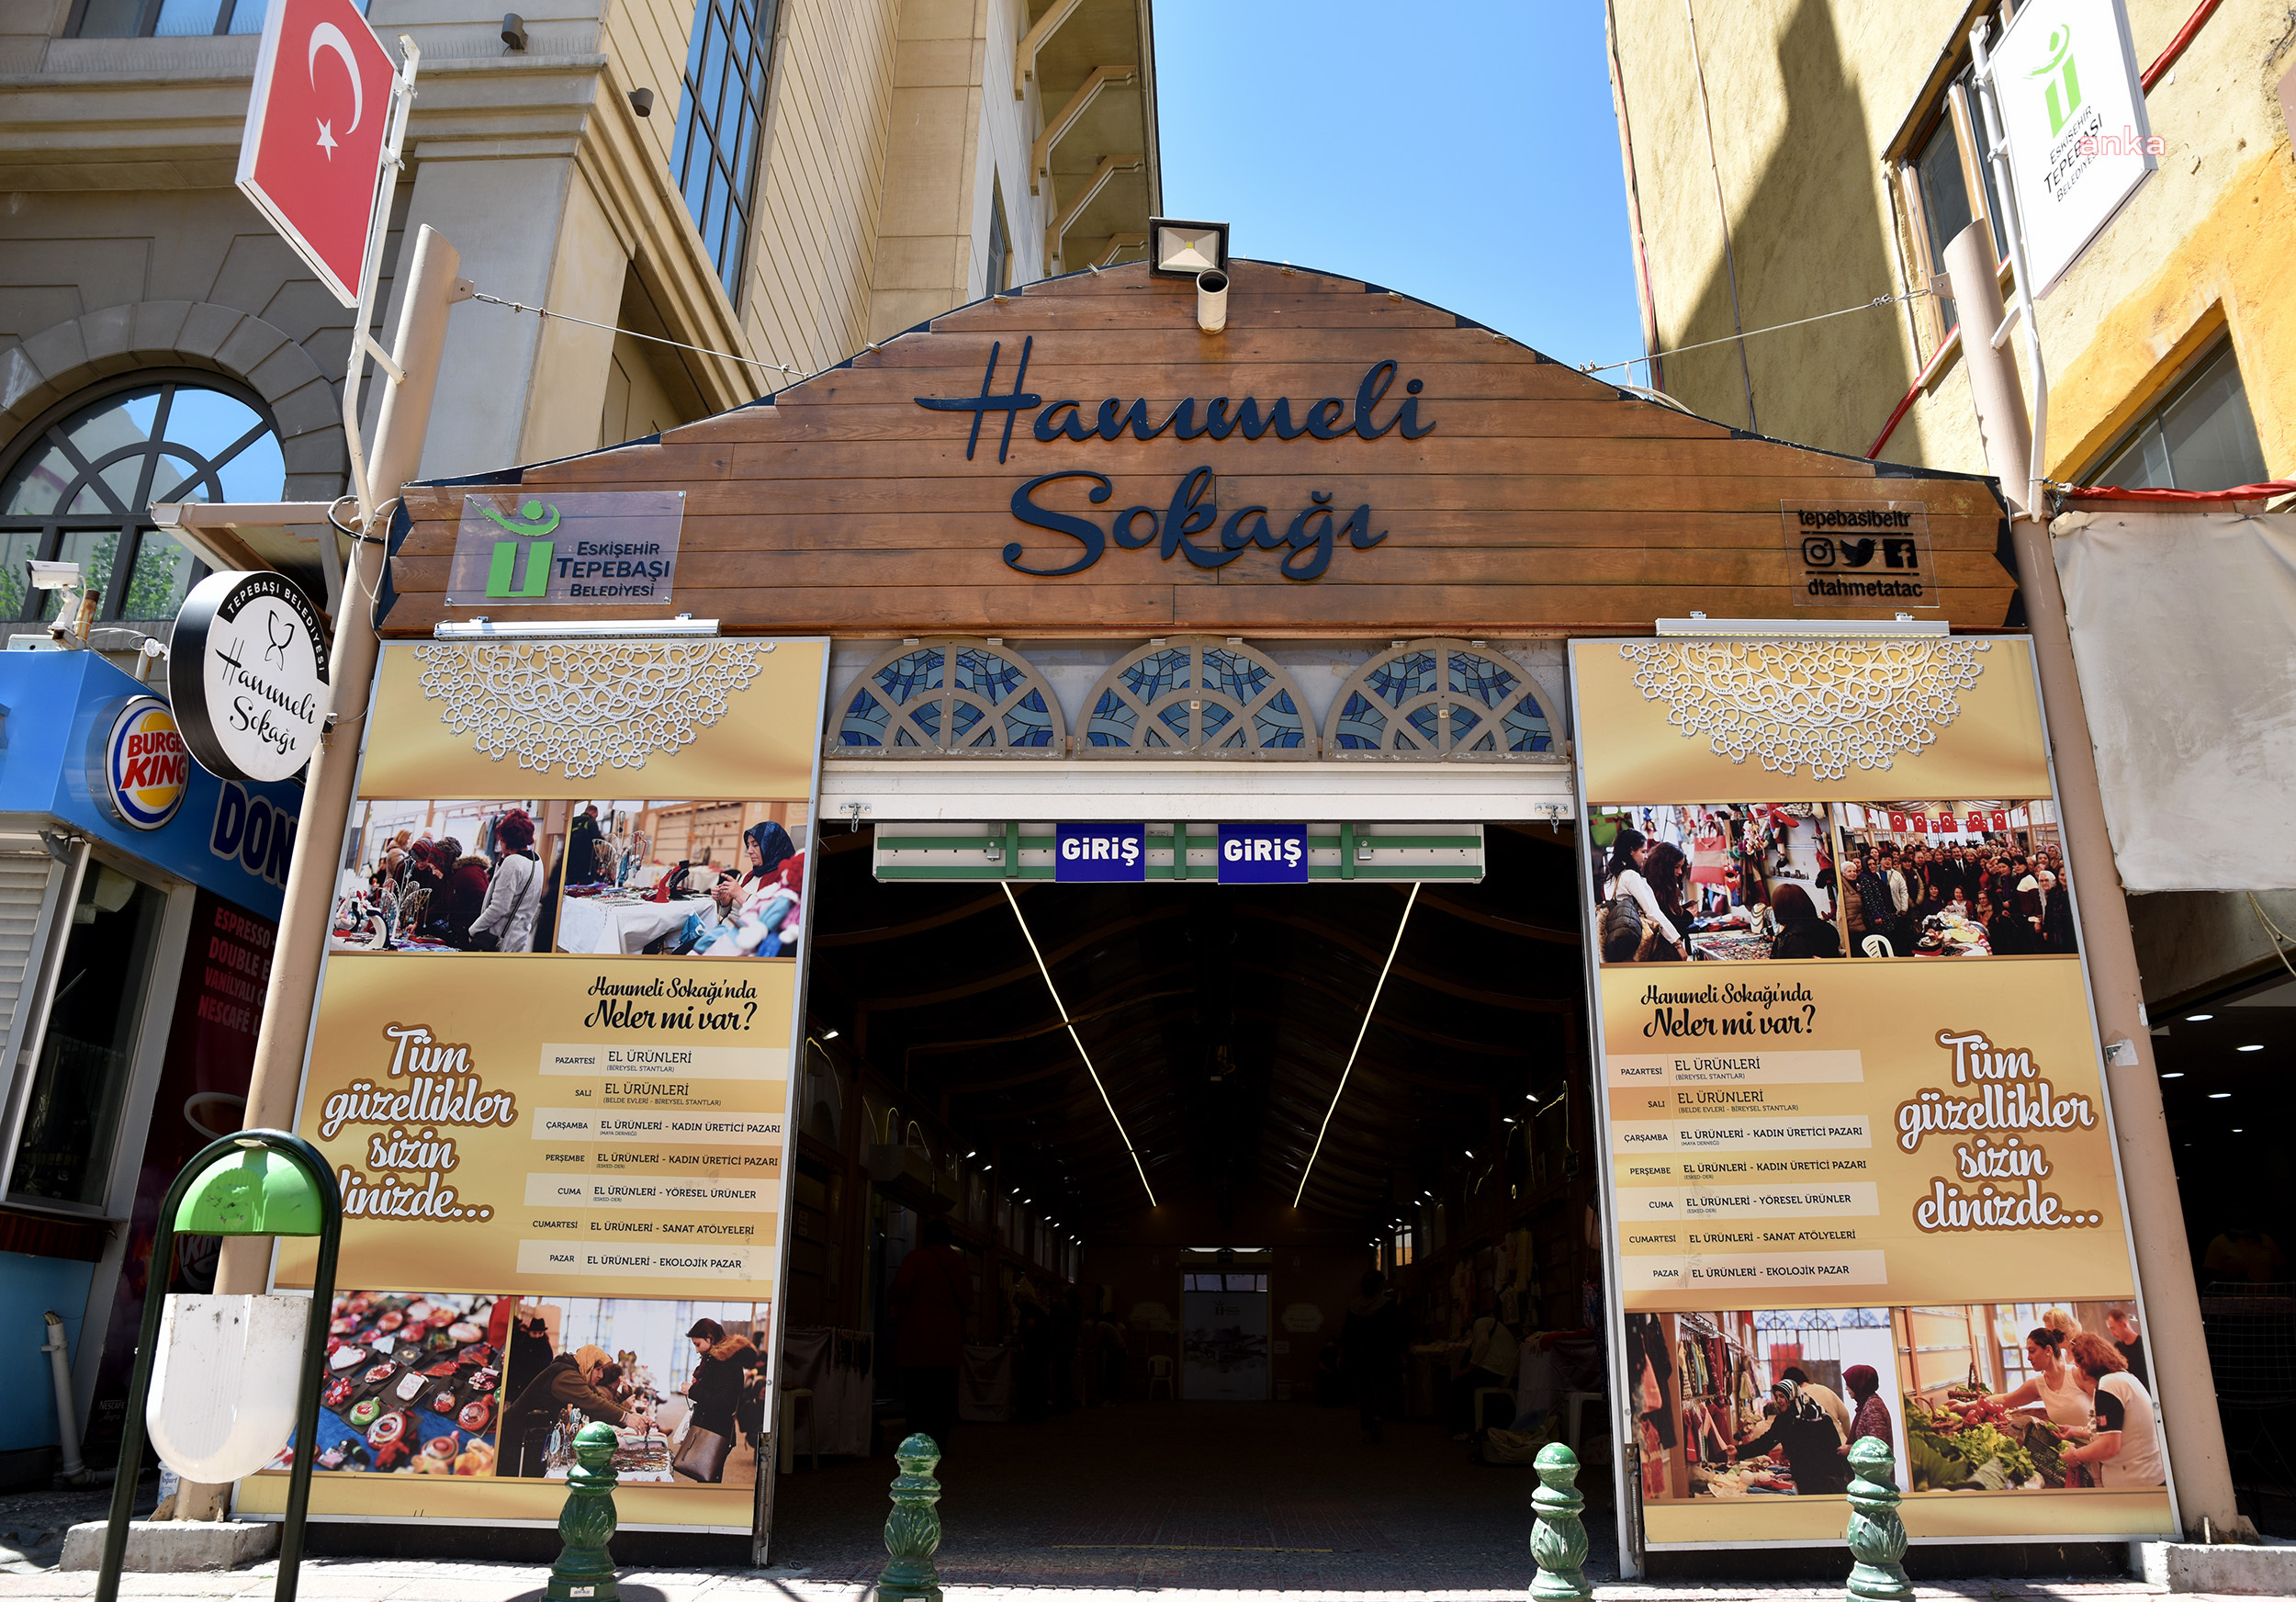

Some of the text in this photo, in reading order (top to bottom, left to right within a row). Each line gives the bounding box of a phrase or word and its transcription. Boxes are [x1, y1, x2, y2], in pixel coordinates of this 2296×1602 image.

[913, 335, 1437, 464] Hanımeli
[1002, 465, 1389, 582] Sokağı
[1798, 509, 1910, 528] tepebasibeltr
[577, 540, 659, 558] ESKİŞEHİR
[557, 558, 670, 581] TEPEBAŞI
[569, 582, 654, 597] BELEDİYESİ
[1808, 578, 1923, 597] dtahmetatac
[227, 581, 279, 615] TEPEBAŞI
[215, 637, 316, 725] Hanımeli
[230, 695, 297, 755] Sokağı
[128, 731, 185, 758] BURGE
[121, 754, 186, 789] KING
[214, 906, 271, 949] ESPRESSO
[208, 935, 261, 977] DOUBLE
[588, 976, 758, 1006] Hanımeli Sokağı'nda
[1640, 982, 1813, 1010] Hanımeli Sokağı'nda
[584, 998, 758, 1031] Neler mi var?
[1643, 1004, 1817, 1037] Neler mi var?
[387, 1026, 470, 1076] Tüm
[608, 1049, 692, 1064] EL ÜRÜNLERİ
[1940, 1032, 2036, 1083] Tüm
[555, 1056, 595, 1065] PAZARTESİ
[1674, 1058, 1761, 1071] EL ÜRÜNLERİ
[639, 1065, 675, 1073] STANTLAR)
[1621, 1066, 1662, 1076] PAZARTESİ
[1709, 1072, 1745, 1080] STANTLAR)
[604, 1081, 689, 1096] EL ÜRÜNLERİ
[1678, 1090, 1764, 1104] EL ÜRÜNLERİ
[321, 1077, 513, 1137] güzellikler
[1898, 1082, 2095, 1149] güzellikler
[546, 1122, 589, 1130] ÇARŞAMBA
[601, 1121, 613, 1129] EL
[614, 1119, 662, 1130] ÜRÜNLERİ
[671, 1123, 703, 1131] KADIN
[705, 1122, 745, 1132] ÜRETİCİ
[747, 1124, 781, 1134] PAZARI
[1681, 1131, 1693, 1140] EL
[1694, 1128, 1744, 1139] ÜRÜNLERİ
[1753, 1129, 1785, 1138] KADIN
[1786, 1126, 1827, 1137] ÜRETİCİ
[1829, 1127, 1863, 1136] PAZARI
[1624, 1134, 1668, 1143] ÇARŞAMBA
[370, 1130, 456, 1169] sizin
[546, 1154, 585, 1163] PERŞEMBE
[597, 1154, 609, 1162] EL
[611, 1153, 659, 1163] ÜRÜNLERİ
[669, 1156, 700, 1165] KADIN
[703, 1155, 741, 1166] ÜRETİCİ
[744, 1157, 778, 1166] PAZARI
[1683, 1164, 1695, 1173] EL
[1697, 1162, 1748, 1172] ÜRÜNLERİ
[1756, 1162, 1788, 1171] KADIN
[1790, 1159, 1830, 1170] ÜRETİCİ
[1832, 1160, 1866, 1169] PAZARI
[1957, 1138, 2049, 1179] sizin
[1630, 1167, 1671, 1177] PERŞEMBE
[340, 1169, 490, 1217] linizde...
[594, 1186, 605, 1195] EL
[608, 1185, 657, 1196] ÜRÜNLERİ
[665, 1187, 708, 1198] YÖRESEL
[710, 1188, 757, 1199] ÜRÜNLER
[1649, 1201, 1673, 1209] CUMA
[1686, 1198, 1698, 1207] EL
[1700, 1196, 1750, 1206] ÜRÜNLERİ
[1759, 1194, 1803, 1205] YÖRESEL
[1805, 1193, 1851, 1204] ÜRÜNLER
[1918, 1179, 2099, 1229] elinizde...
[533, 1220, 578, 1229] CUMARTESİ
[591, 1223, 602, 1231] EL
[604, 1221, 653, 1232] ÜRÜNLERİ
[662, 1224, 694, 1234] SANAT
[696, 1224, 754, 1235] ATÖLYELERİ
[1629, 1235, 1676, 1244] CUMARTESİ
[1690, 1235, 1701, 1243] EL
[1703, 1232, 1753, 1243] ÜRÜNLERİ
[1763, 1233, 1795, 1241] SANAT
[1798, 1229, 1856, 1241] ATÖLYELERİ
[587, 1256, 599, 1264] EL
[601, 1255, 650, 1266] ÜRÜNLERİ
[659, 1257, 708, 1268] EKOLOJİK
[710, 1259, 742, 1269] PAZAR
[1692, 1269, 1704, 1278] EL
[1705, 1267, 1757, 1277] ÜRÜNLERİ
[1766, 1266, 1816, 1276] EKOLOJİK
[1818, 1265, 1850, 1274] PAZAR
